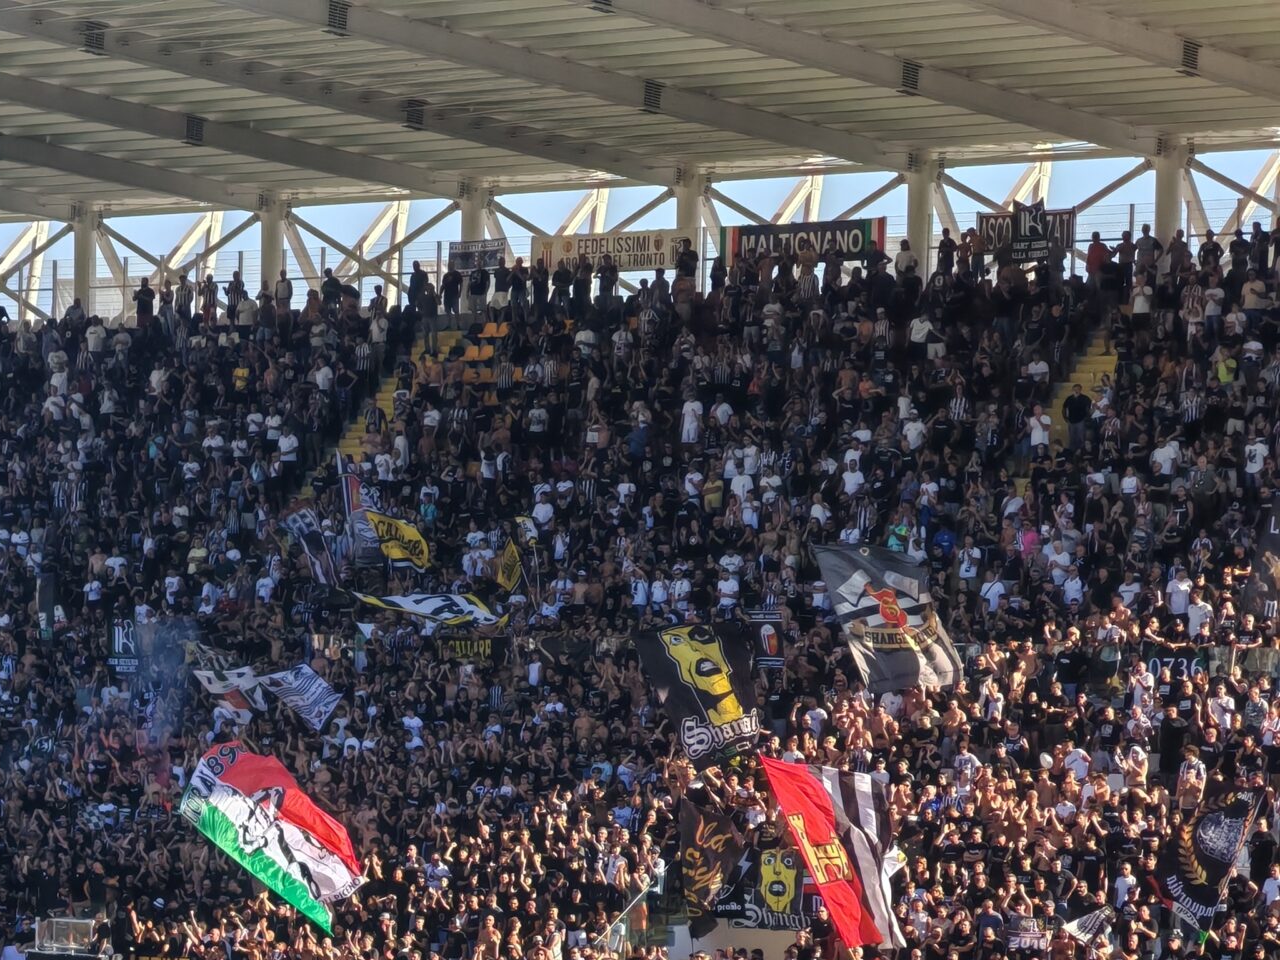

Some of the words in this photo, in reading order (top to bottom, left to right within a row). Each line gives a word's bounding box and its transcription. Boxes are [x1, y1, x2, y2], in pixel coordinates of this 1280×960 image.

[577, 235, 651, 254] FEDELISSIMI
[741, 228, 863, 258] MALTIGNANO
[627, 252, 665, 267] TRONTO
[1149, 657, 1203, 680] 0736
